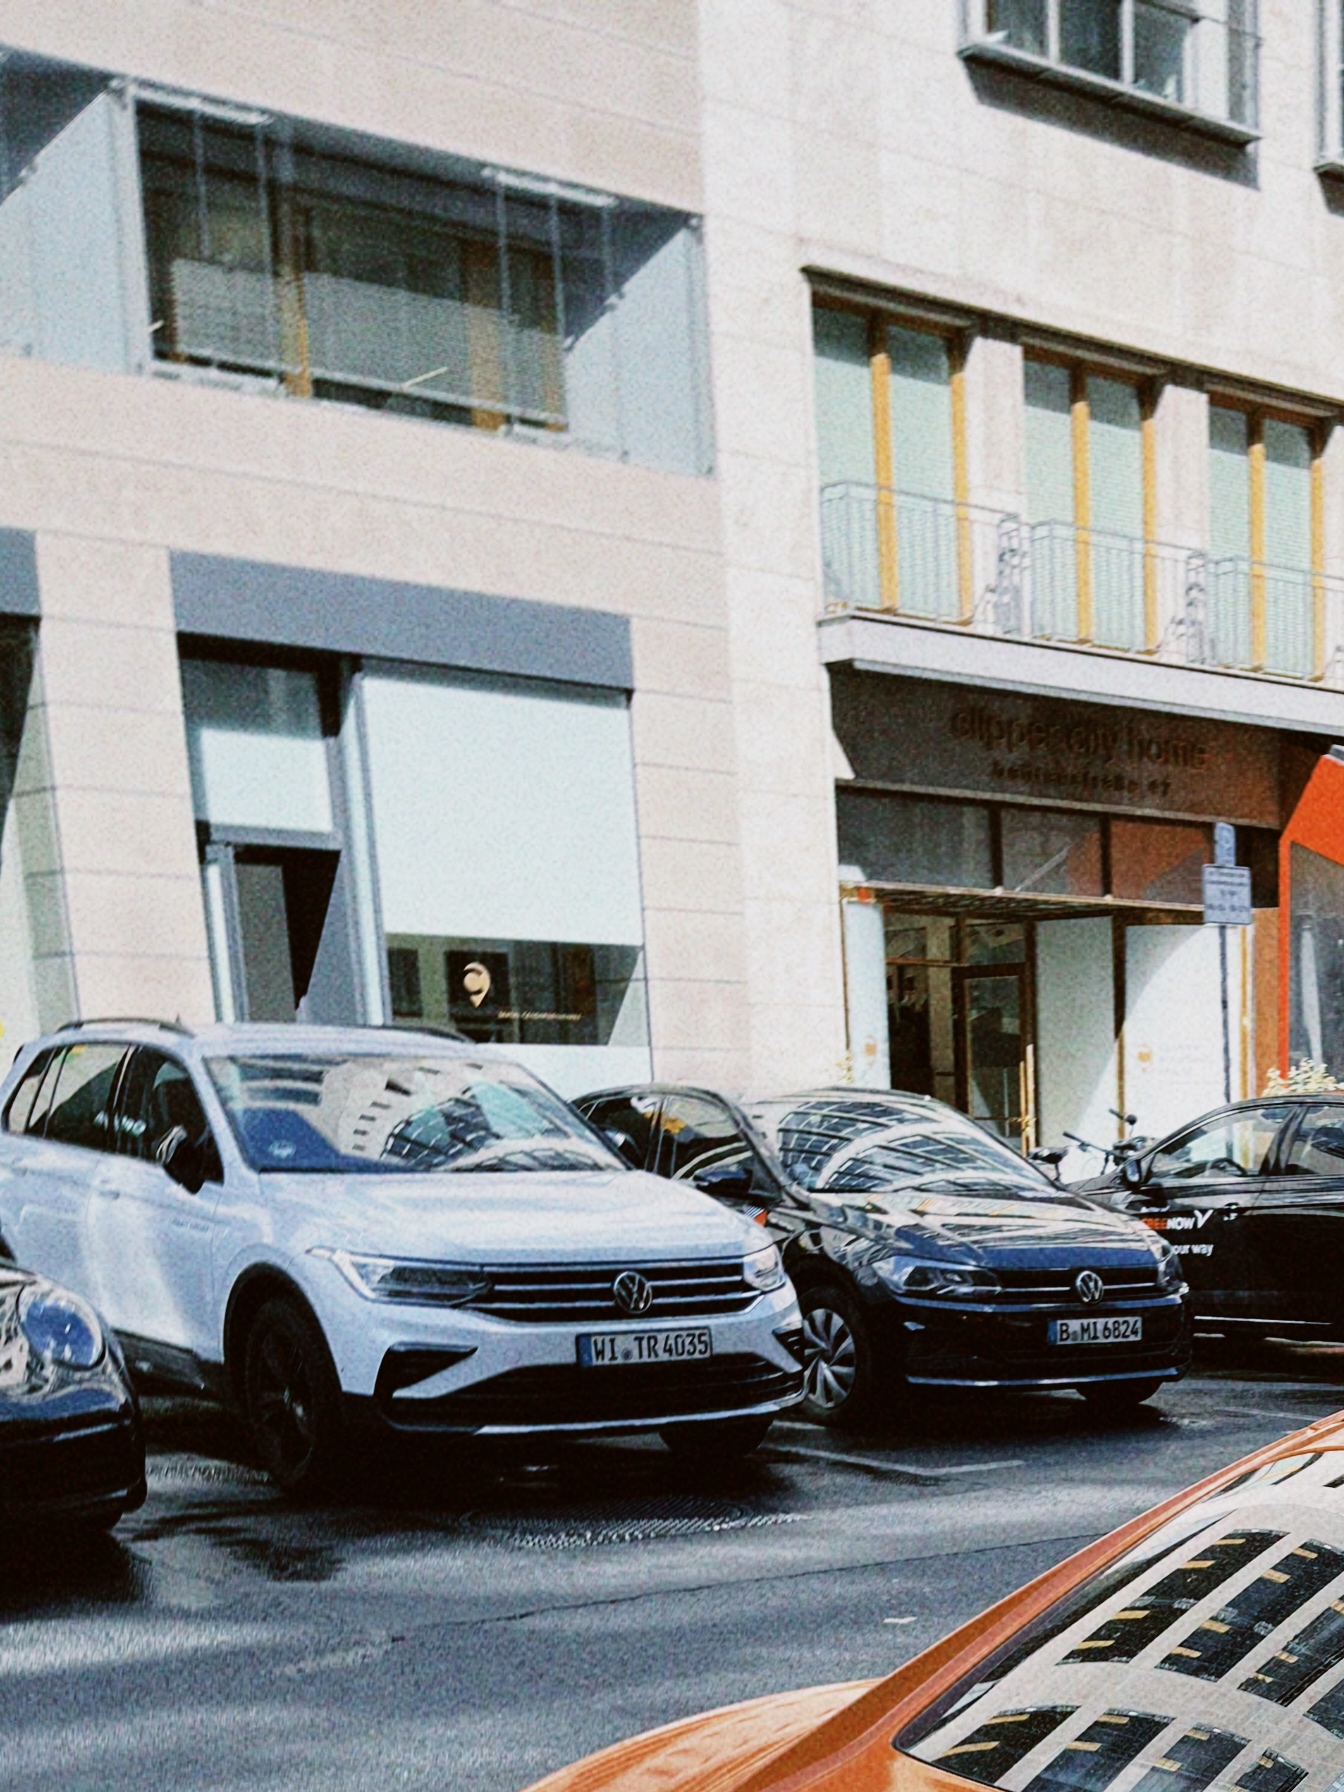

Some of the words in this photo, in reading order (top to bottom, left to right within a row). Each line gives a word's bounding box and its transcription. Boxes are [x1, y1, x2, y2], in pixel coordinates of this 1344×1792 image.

[1191, 1243, 1214, 1257] way
[1059, 1322, 1070, 1342] B
[1080, 1320, 1099, 1341] MI
[1102, 1319, 1139, 1340] 6824
[593, 1337, 619, 1362] WI
[633, 1335, 660, 1359] TR
[663, 1332, 709, 1357] 4035
